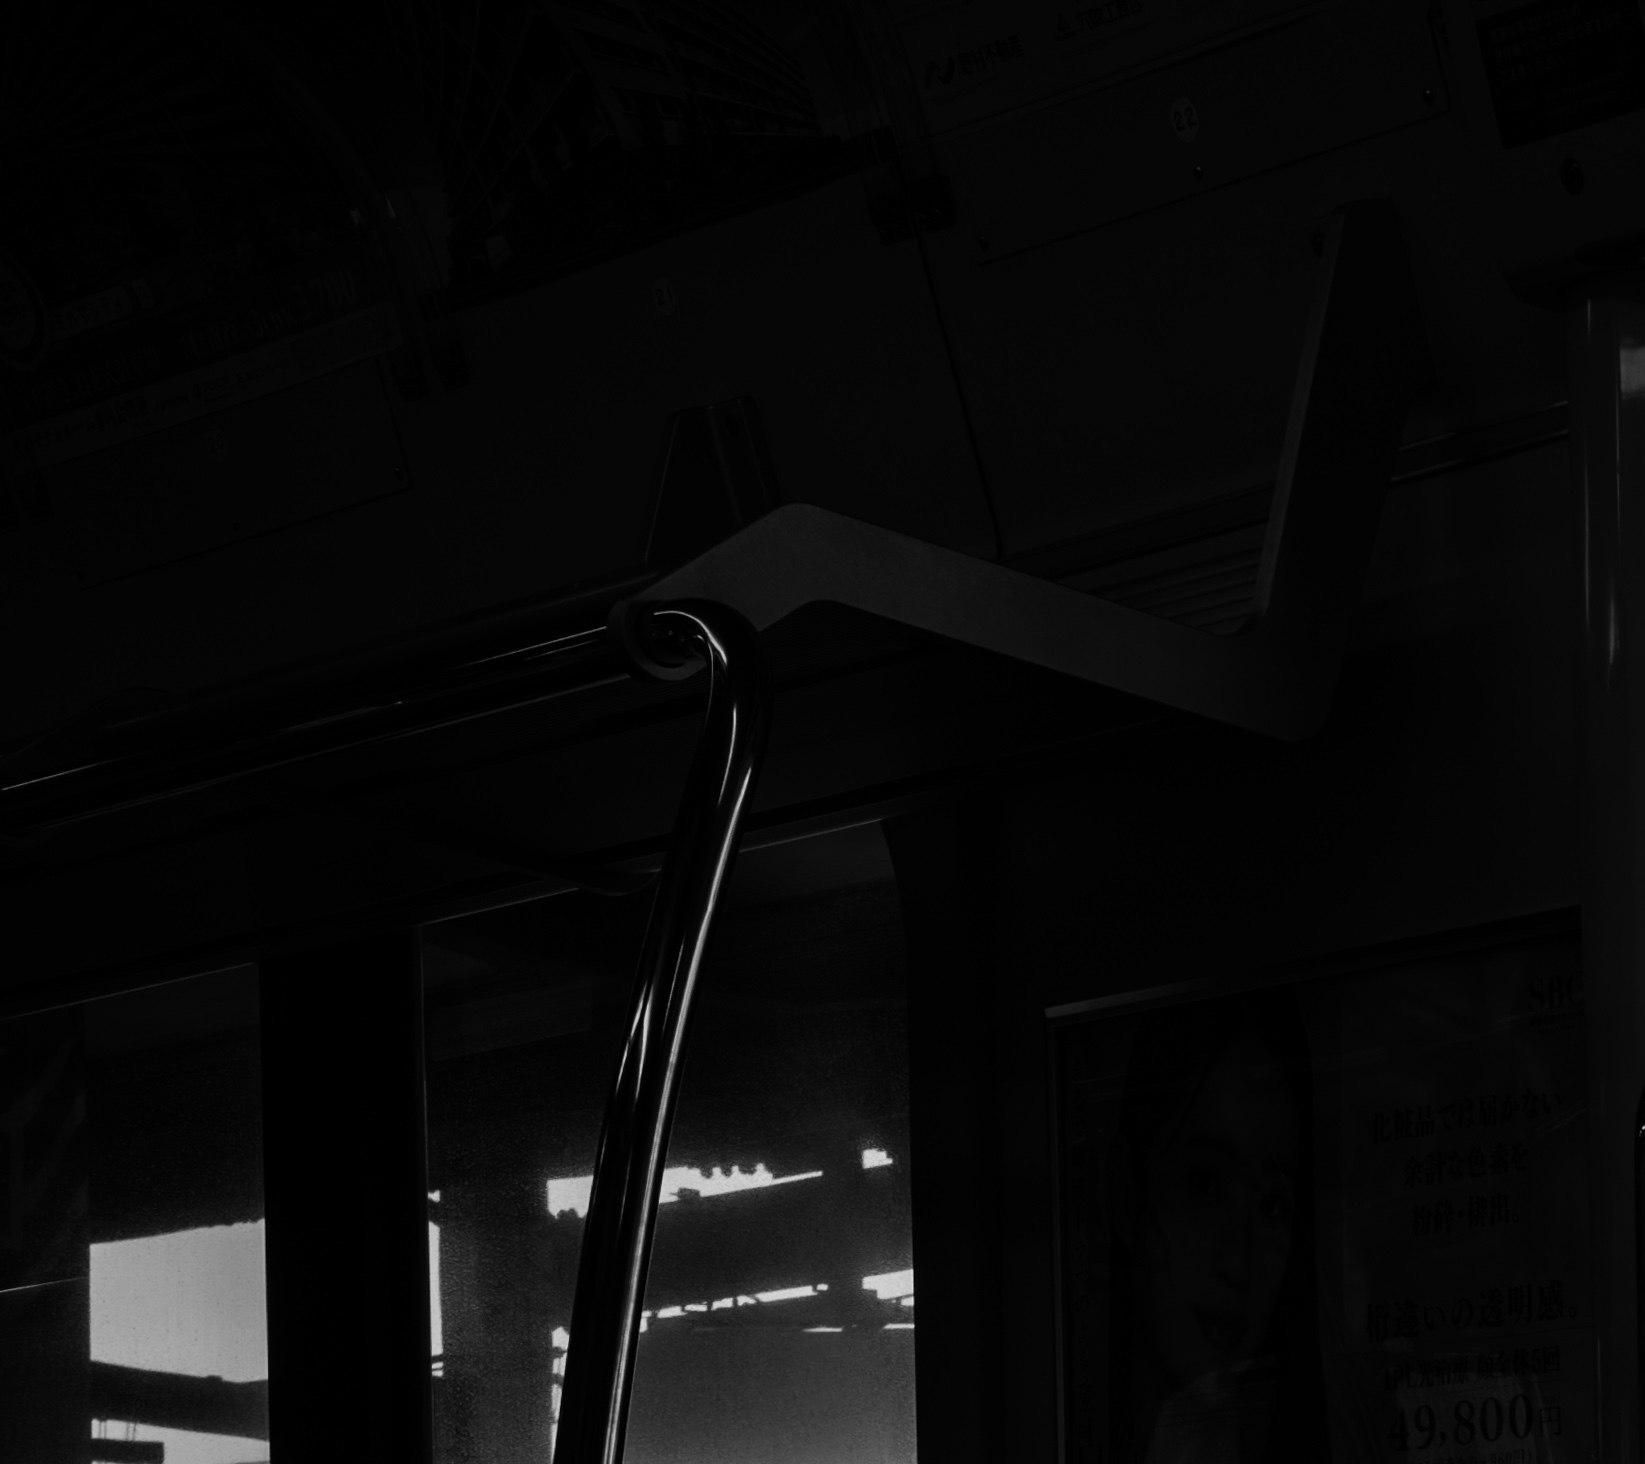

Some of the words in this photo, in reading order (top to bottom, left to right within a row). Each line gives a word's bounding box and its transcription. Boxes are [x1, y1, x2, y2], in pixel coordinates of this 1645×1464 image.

[1173, 106, 1197, 132] 22
[1373, 1089, 1562, 1145] 化粧品では届かない
[1404, 1141, 1528, 1188] 余計な色素を
[1366, 1280, 1577, 1344] 桁違いの透明感。
